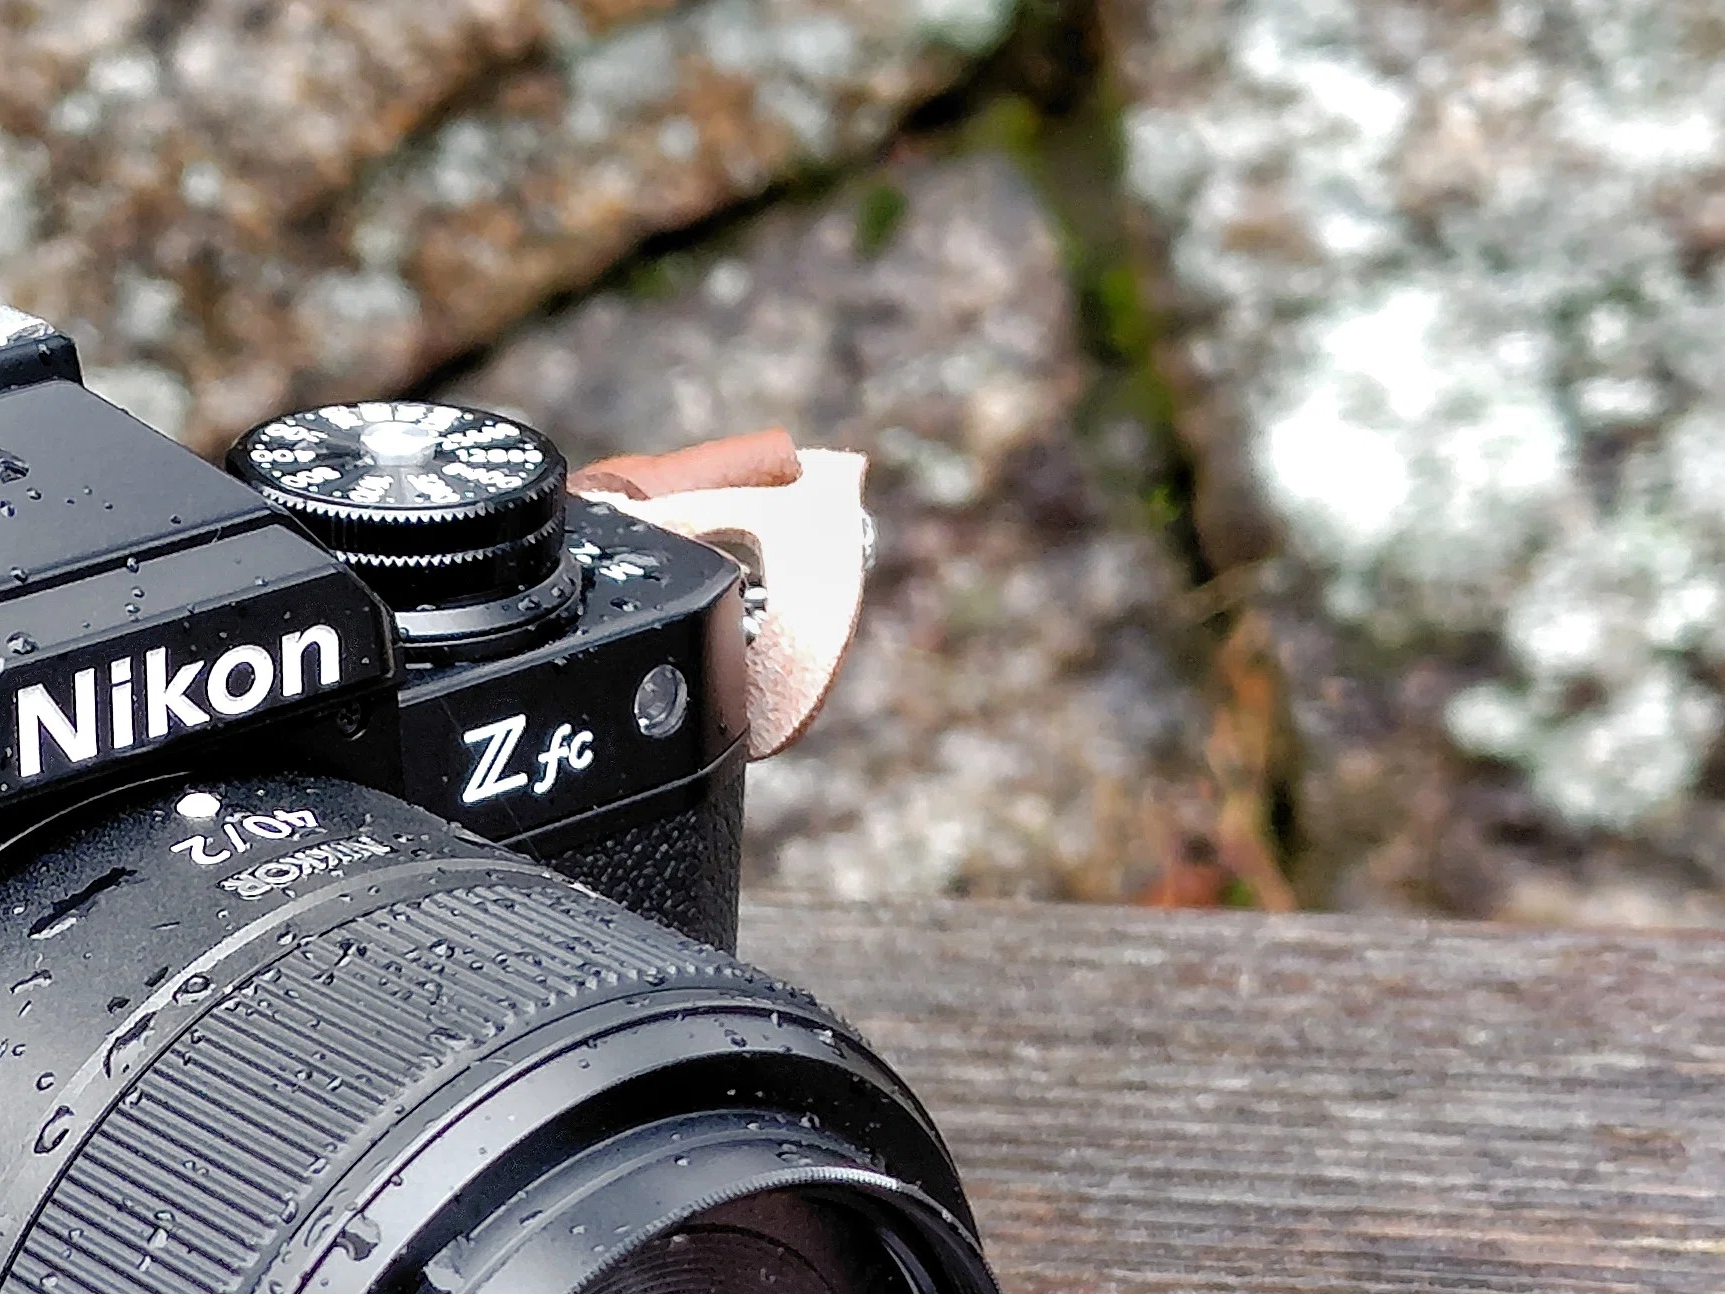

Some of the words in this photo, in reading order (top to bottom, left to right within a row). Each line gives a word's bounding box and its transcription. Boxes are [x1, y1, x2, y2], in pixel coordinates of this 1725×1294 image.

[16, 624, 341, 778] Nikon
[461, 714, 529, 804] Z
[171, 808, 320, 867] 40/2
[216, 836, 393, 899] NIKKOR
